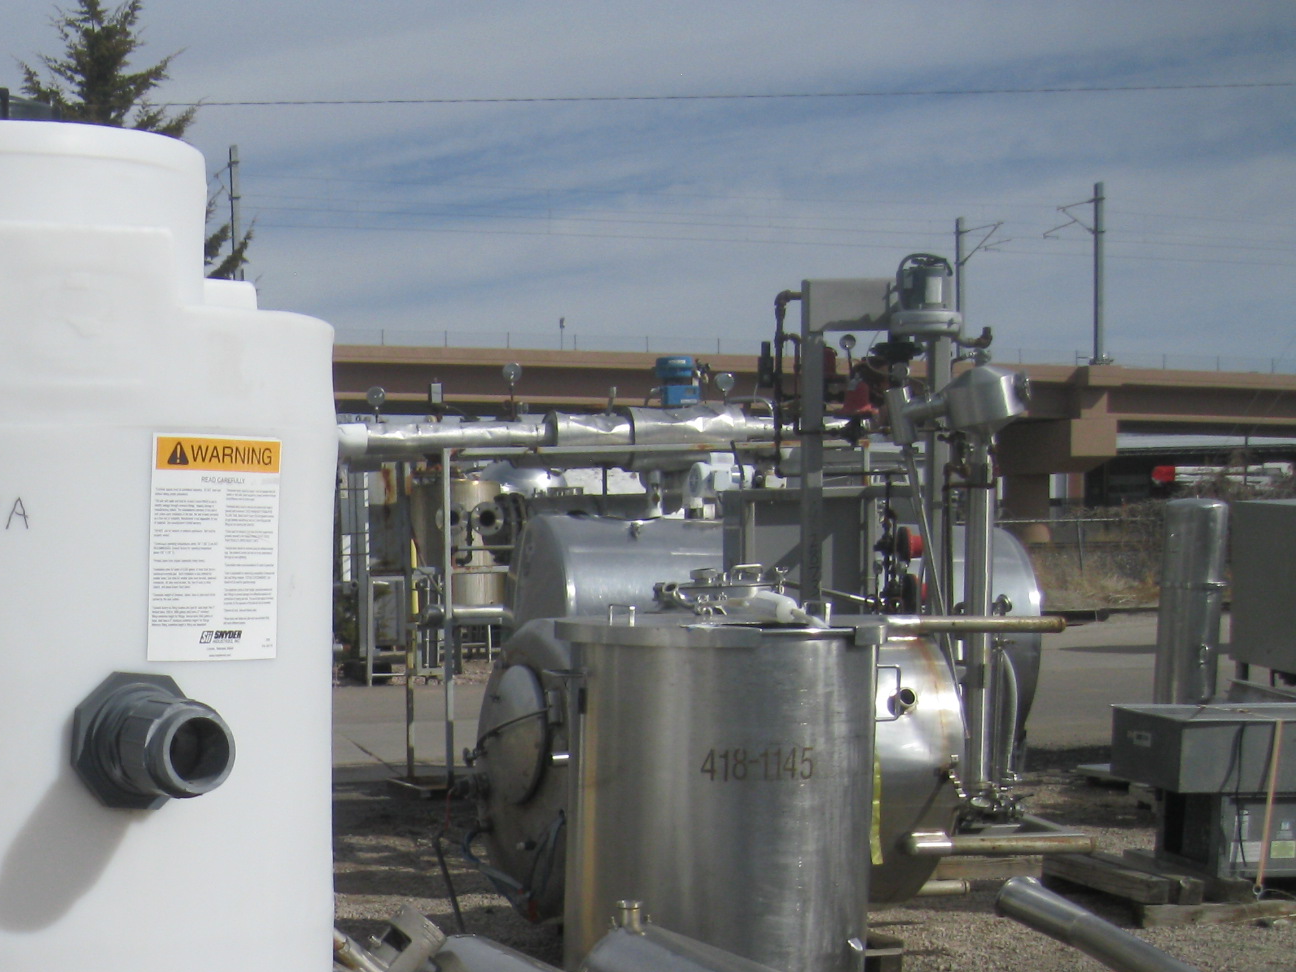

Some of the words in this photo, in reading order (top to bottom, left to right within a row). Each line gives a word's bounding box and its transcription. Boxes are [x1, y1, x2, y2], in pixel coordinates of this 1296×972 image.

[191, 444, 272, 466] WARNING
[201, 476, 217, 484] READ
[217, 476, 245, 485] CAREFULLY
[214, 630, 242, 639] SNYDER
[700, 747, 814, 782] 418-1145
